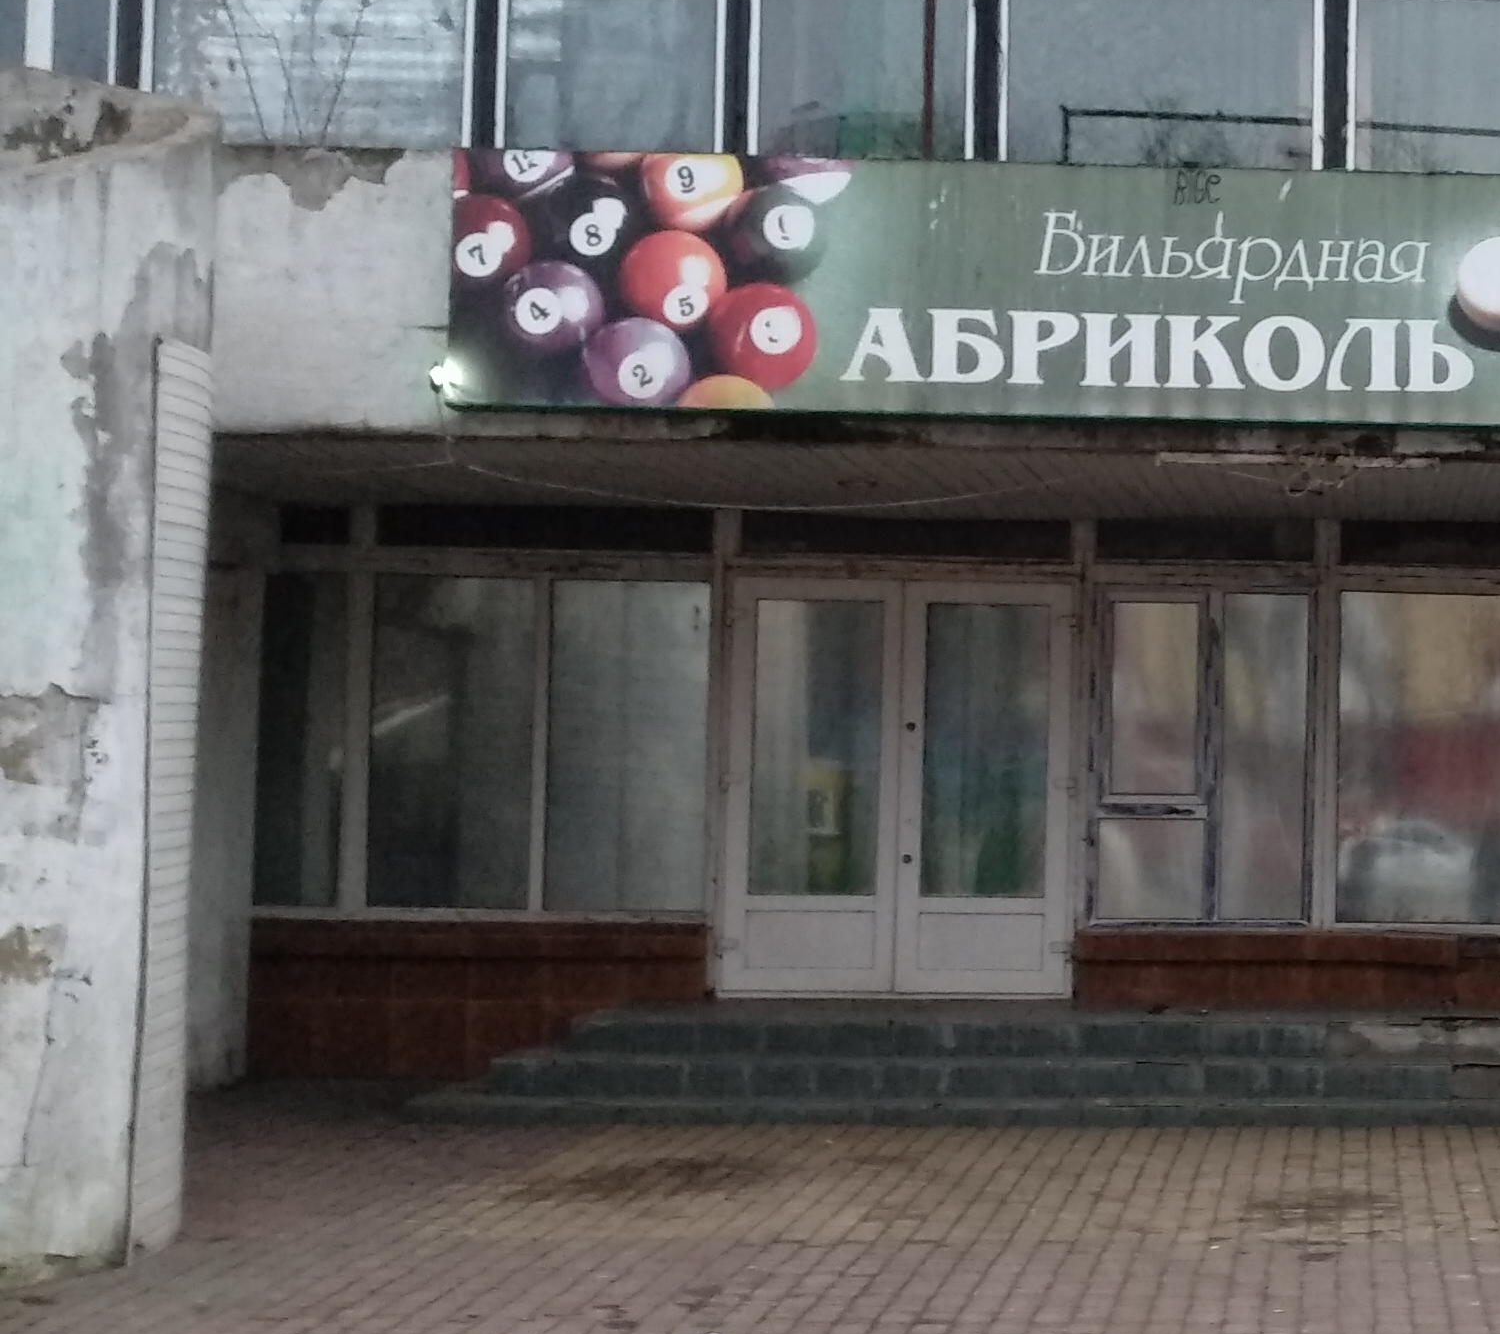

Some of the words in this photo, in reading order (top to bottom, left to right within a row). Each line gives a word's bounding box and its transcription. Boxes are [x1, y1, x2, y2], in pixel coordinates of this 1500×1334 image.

[678, 166, 696, 193] 9
[585, 224, 602, 247] 8
[468, 243, 486, 266] 7
[1034, 209, 1429, 303] Бильярдная
[529, 300, 550, 321] 4
[678, 296, 695, 317] 5
[840, 307, 1475, 392] АБРИКОЛЬ
[632, 364, 653, 387] 2
